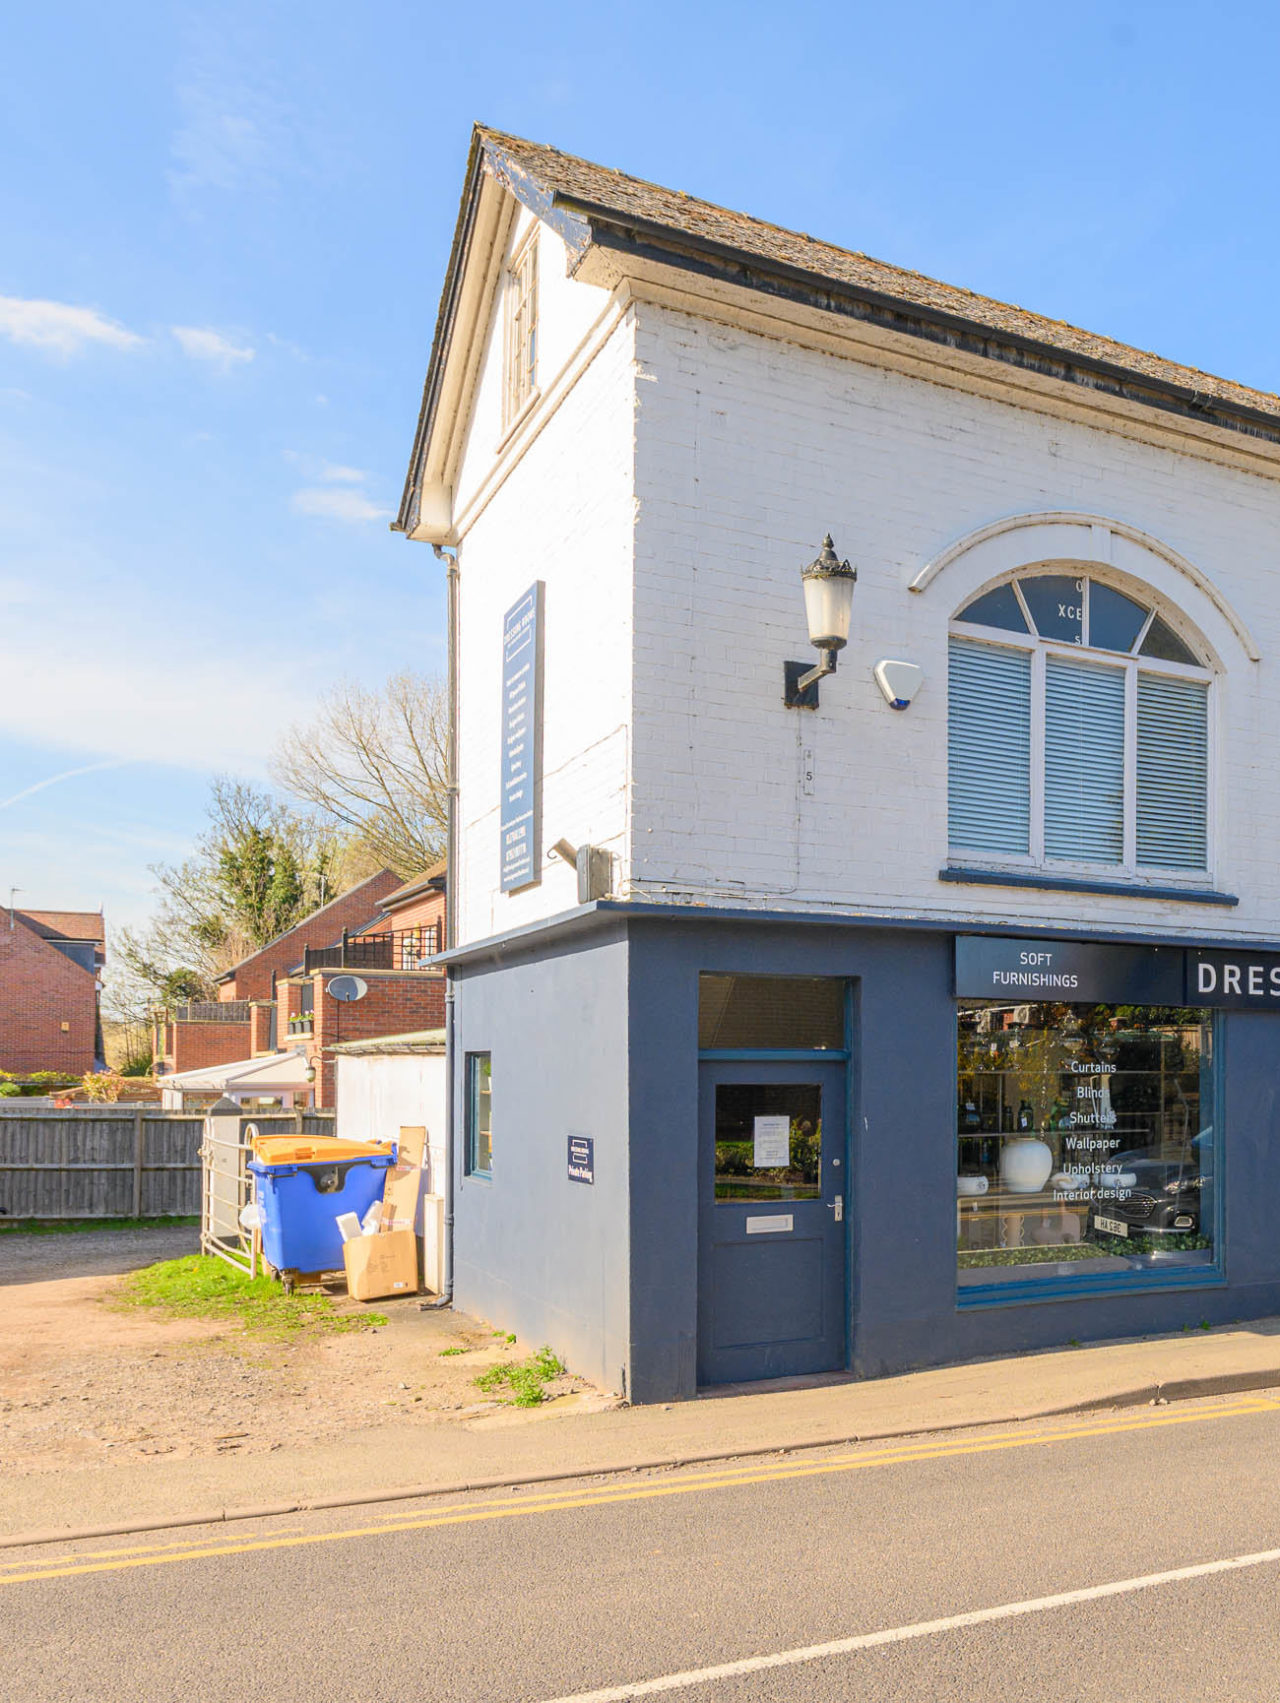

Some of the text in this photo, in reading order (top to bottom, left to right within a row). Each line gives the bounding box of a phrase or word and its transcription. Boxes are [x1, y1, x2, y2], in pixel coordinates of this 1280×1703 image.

[1020, 952, 1053, 967] SOFT
[993, 971, 1079, 988] FURNISHINGS
[1071, 1061, 1117, 1073] Curtains
[1069, 1111, 1117, 1124] Shutters
[1065, 1137, 1121, 1152] Wallpaper
[1063, 1162, 1122, 1175] Upholstery
[1053, 1186, 1132, 1201] Interior design
